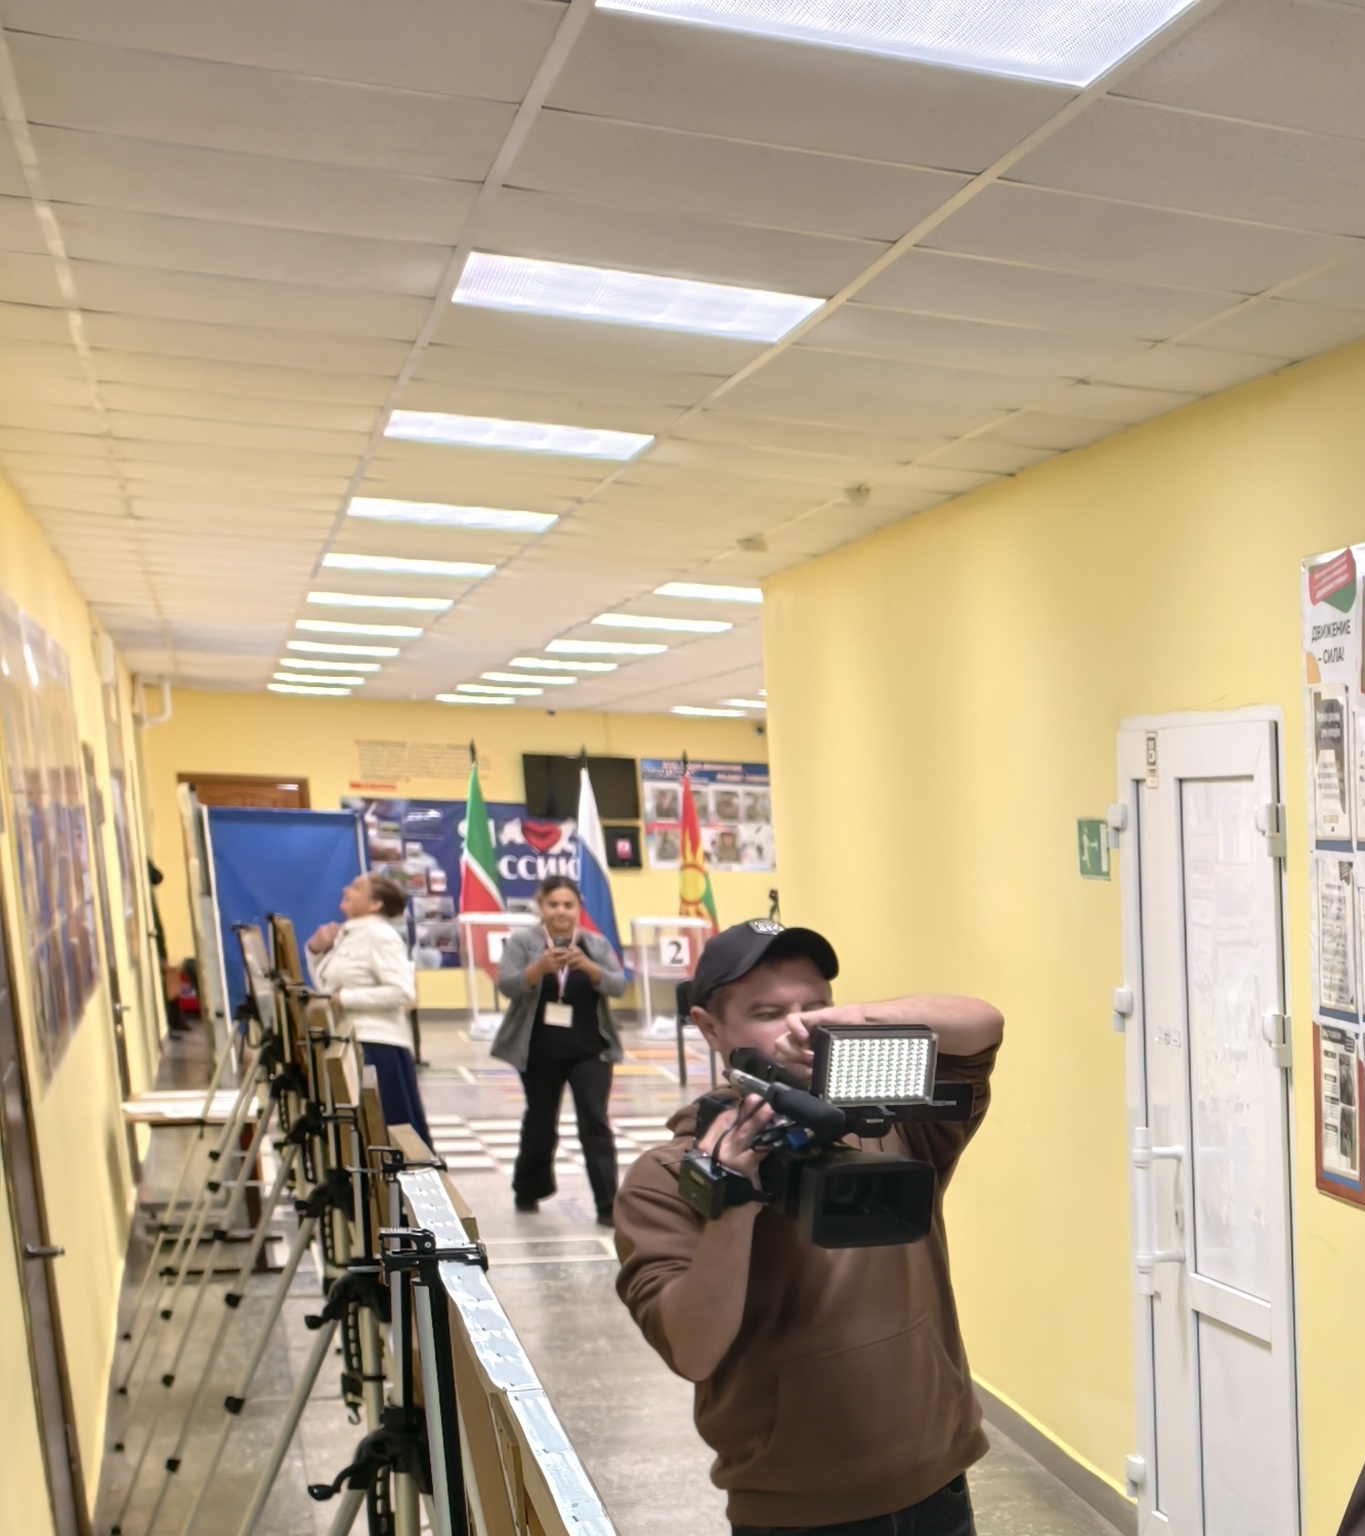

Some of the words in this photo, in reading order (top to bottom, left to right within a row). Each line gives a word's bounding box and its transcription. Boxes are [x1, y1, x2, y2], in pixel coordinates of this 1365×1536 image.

[1311, 619, 1351, 644] ДВИЖЕНИЕ
[1323, 646, 1345, 664] СИЛА!
[668, 940, 684, 964] 2
